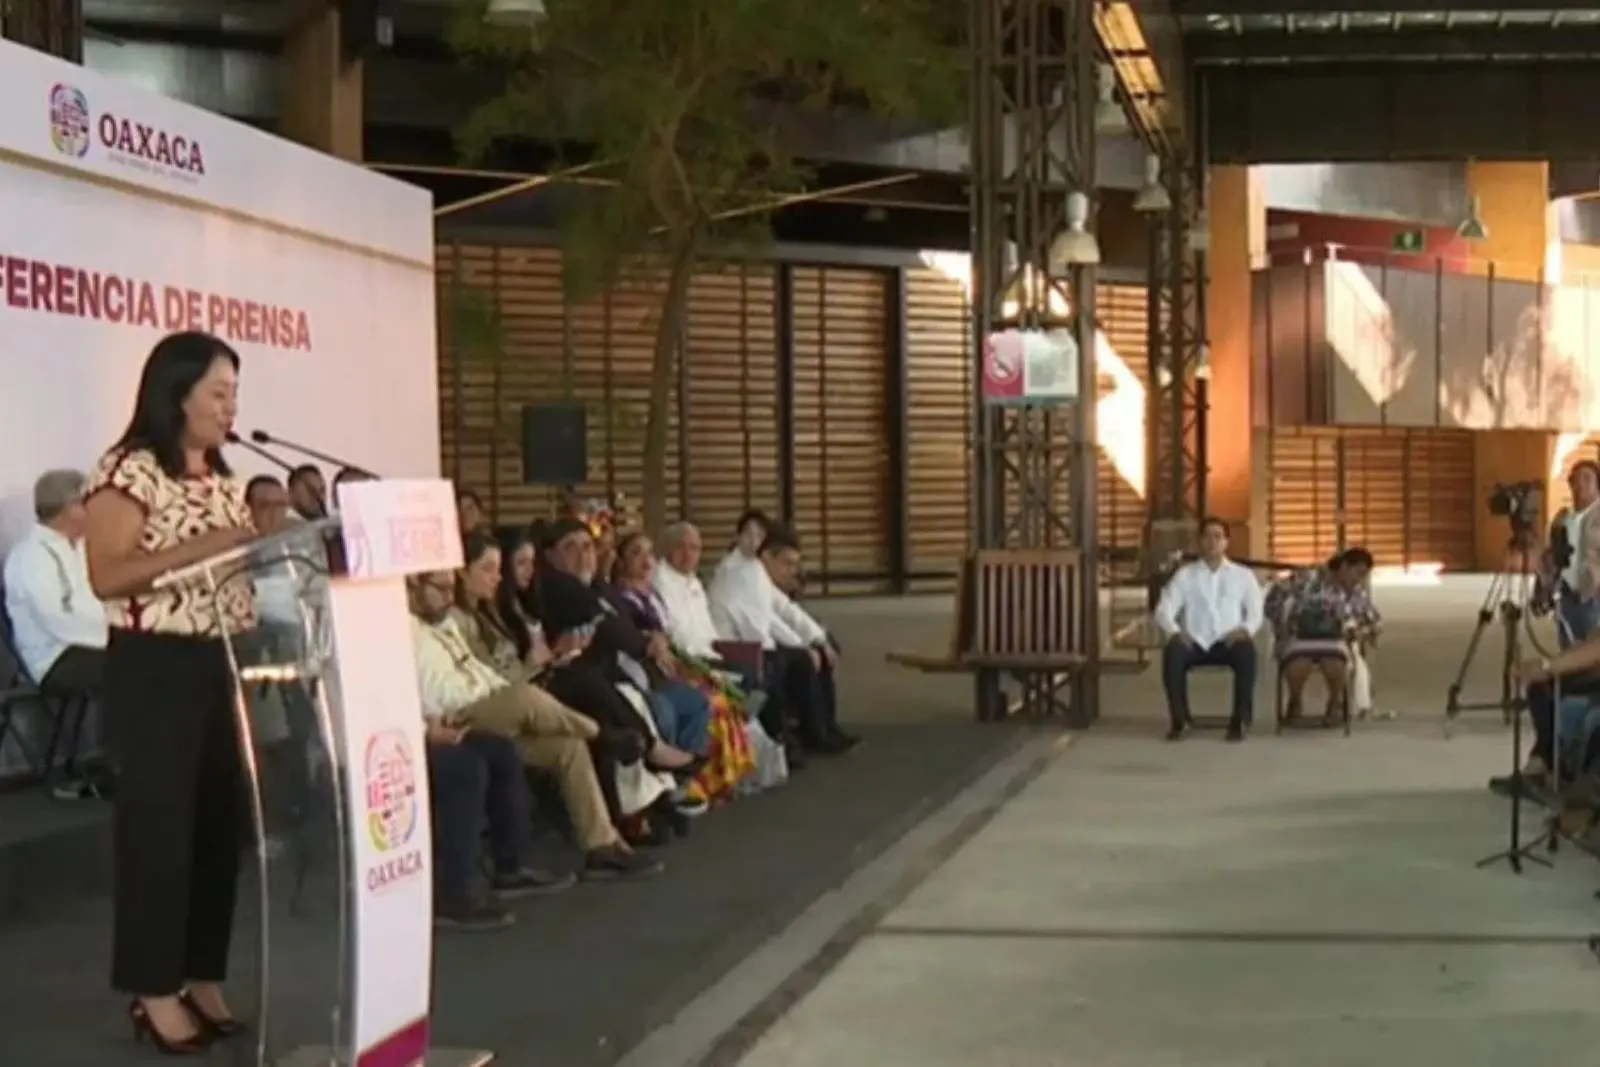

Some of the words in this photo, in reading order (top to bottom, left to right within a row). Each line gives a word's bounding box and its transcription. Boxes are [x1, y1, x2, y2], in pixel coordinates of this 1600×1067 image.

[99, 113, 205, 175] OAXACA
[0, 256, 158, 329] ERENCIA
[164, 285, 202, 331] DE
[208, 291, 312, 351] PRENSA
[367, 850, 423, 891] OAXACA
